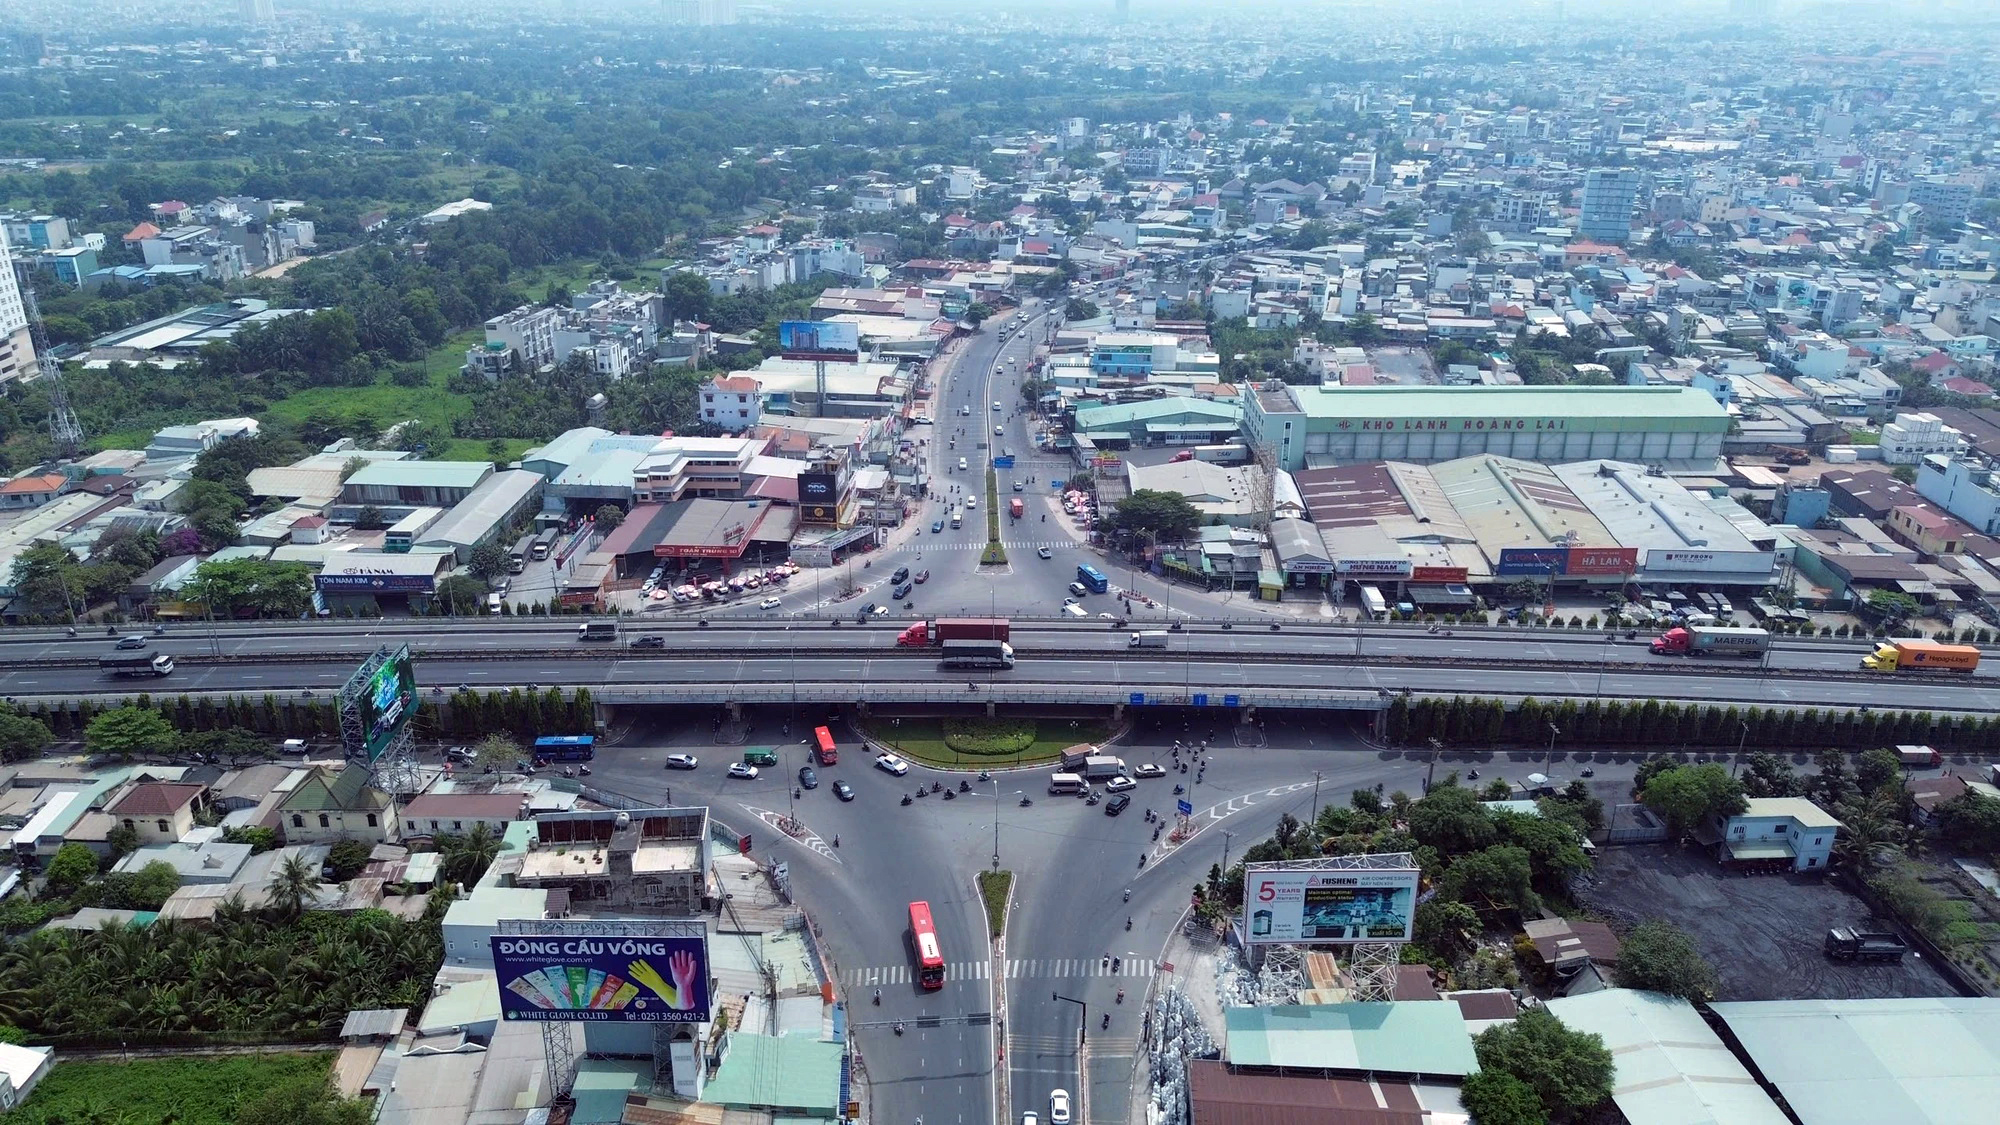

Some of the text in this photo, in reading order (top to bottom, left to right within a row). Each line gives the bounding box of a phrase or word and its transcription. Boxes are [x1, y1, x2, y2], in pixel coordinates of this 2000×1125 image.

[1362, 420, 1394, 430] KHO
[1536, 420, 1565, 430] LAI
[1582, 556, 1621, 566] HÀ LAN
[1714, 637, 1759, 645] MAERSK
[1321, 877, 1358, 885] FUSHENG
[1258, 880, 1276, 902] 5
[499, 939, 560, 955] ĐÔNG
[563, 938, 604, 956] CẦU
[505, 956, 593, 964] www.whiteglove.com.vn
[519, 1011, 547, 1020] WHITE
[548, 1011, 575, 1020] GLOVE
[641, 1012, 661, 1021] 0251
[662, 1012, 682, 1021] 3560
[682, 1012, 706, 1021] 421-2
